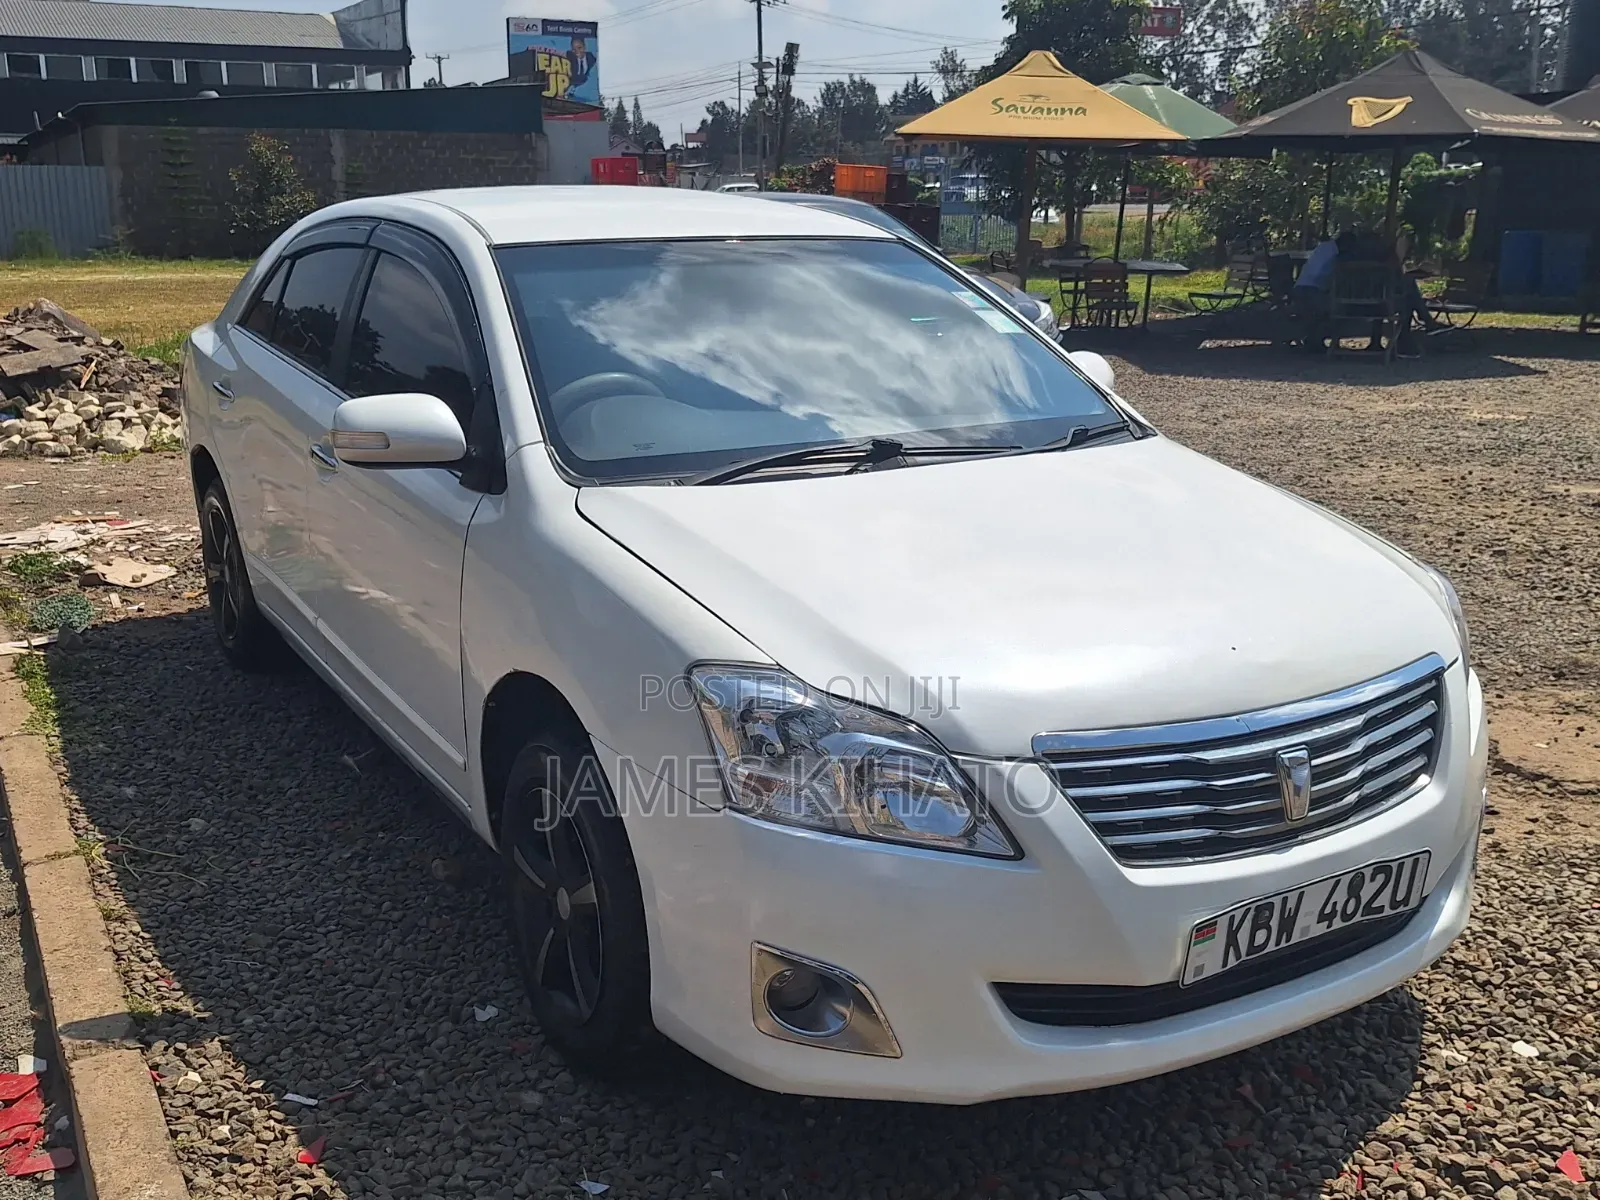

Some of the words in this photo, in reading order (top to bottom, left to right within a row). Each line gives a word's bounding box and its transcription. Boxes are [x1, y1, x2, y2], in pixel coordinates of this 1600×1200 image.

[547, 25, 558, 33] Text
[989, 97, 1088, 116] Savanna
[1221, 890, 1305, 969] KBW
[1316, 857, 1420, 930] 482U
